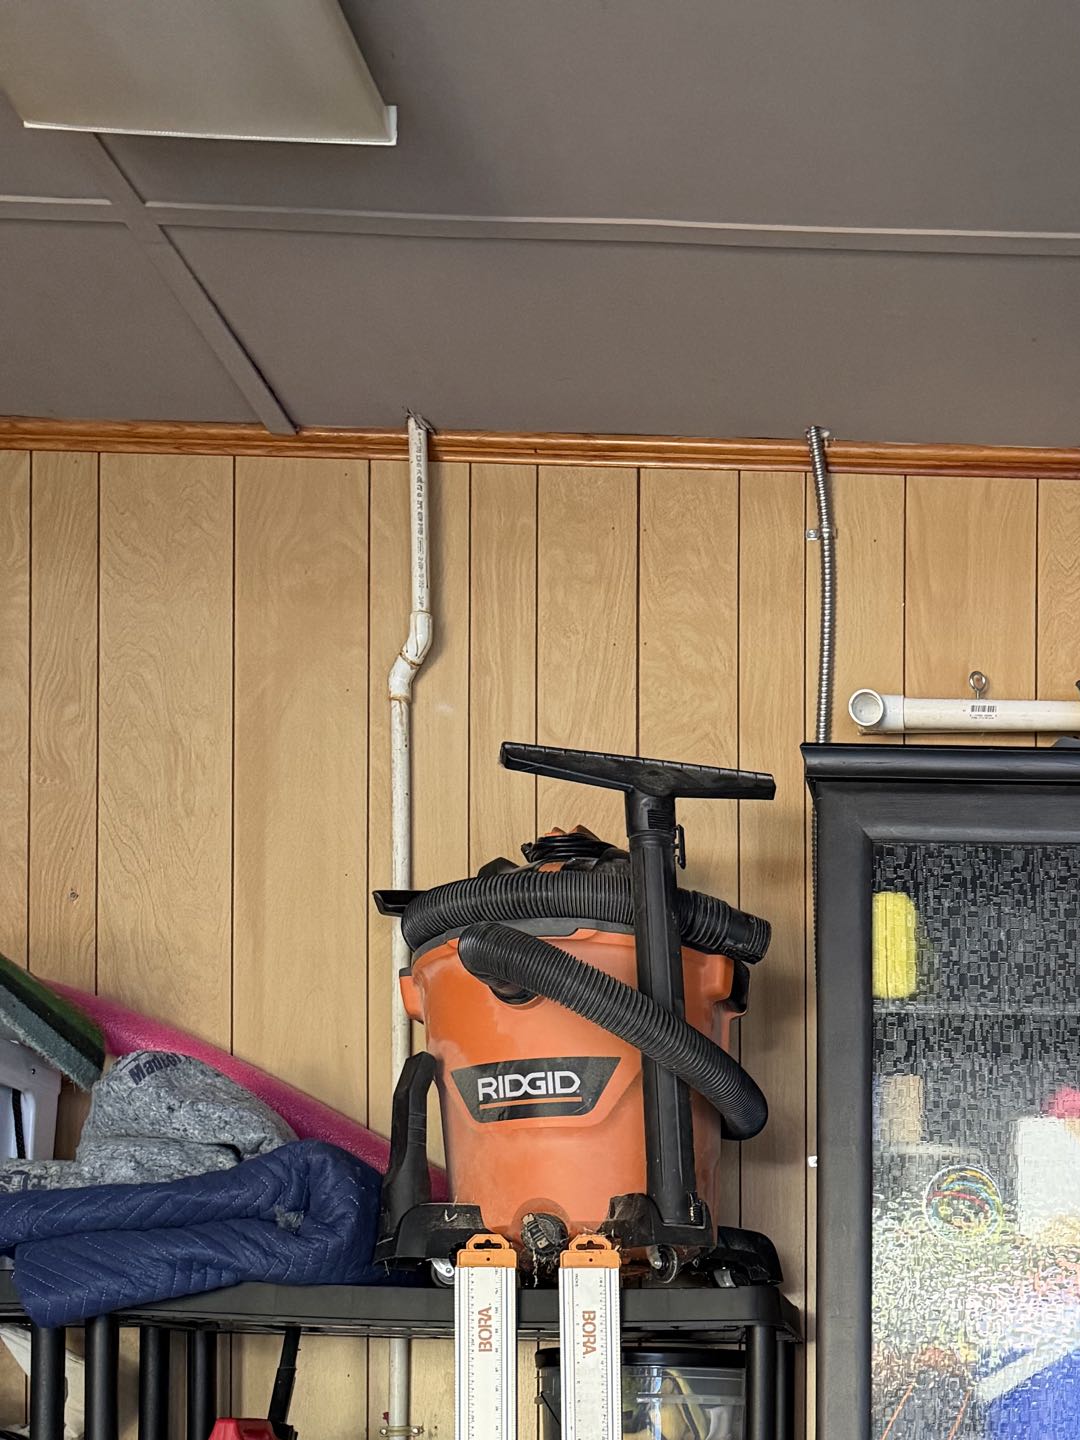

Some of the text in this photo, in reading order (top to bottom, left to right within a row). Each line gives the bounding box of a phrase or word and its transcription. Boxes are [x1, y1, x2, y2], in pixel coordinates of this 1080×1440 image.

[477, 1070, 581, 1101] RIDGID
[478, 1306, 493, 1353] BORA
[582, 1310, 597, 1356] BORA
